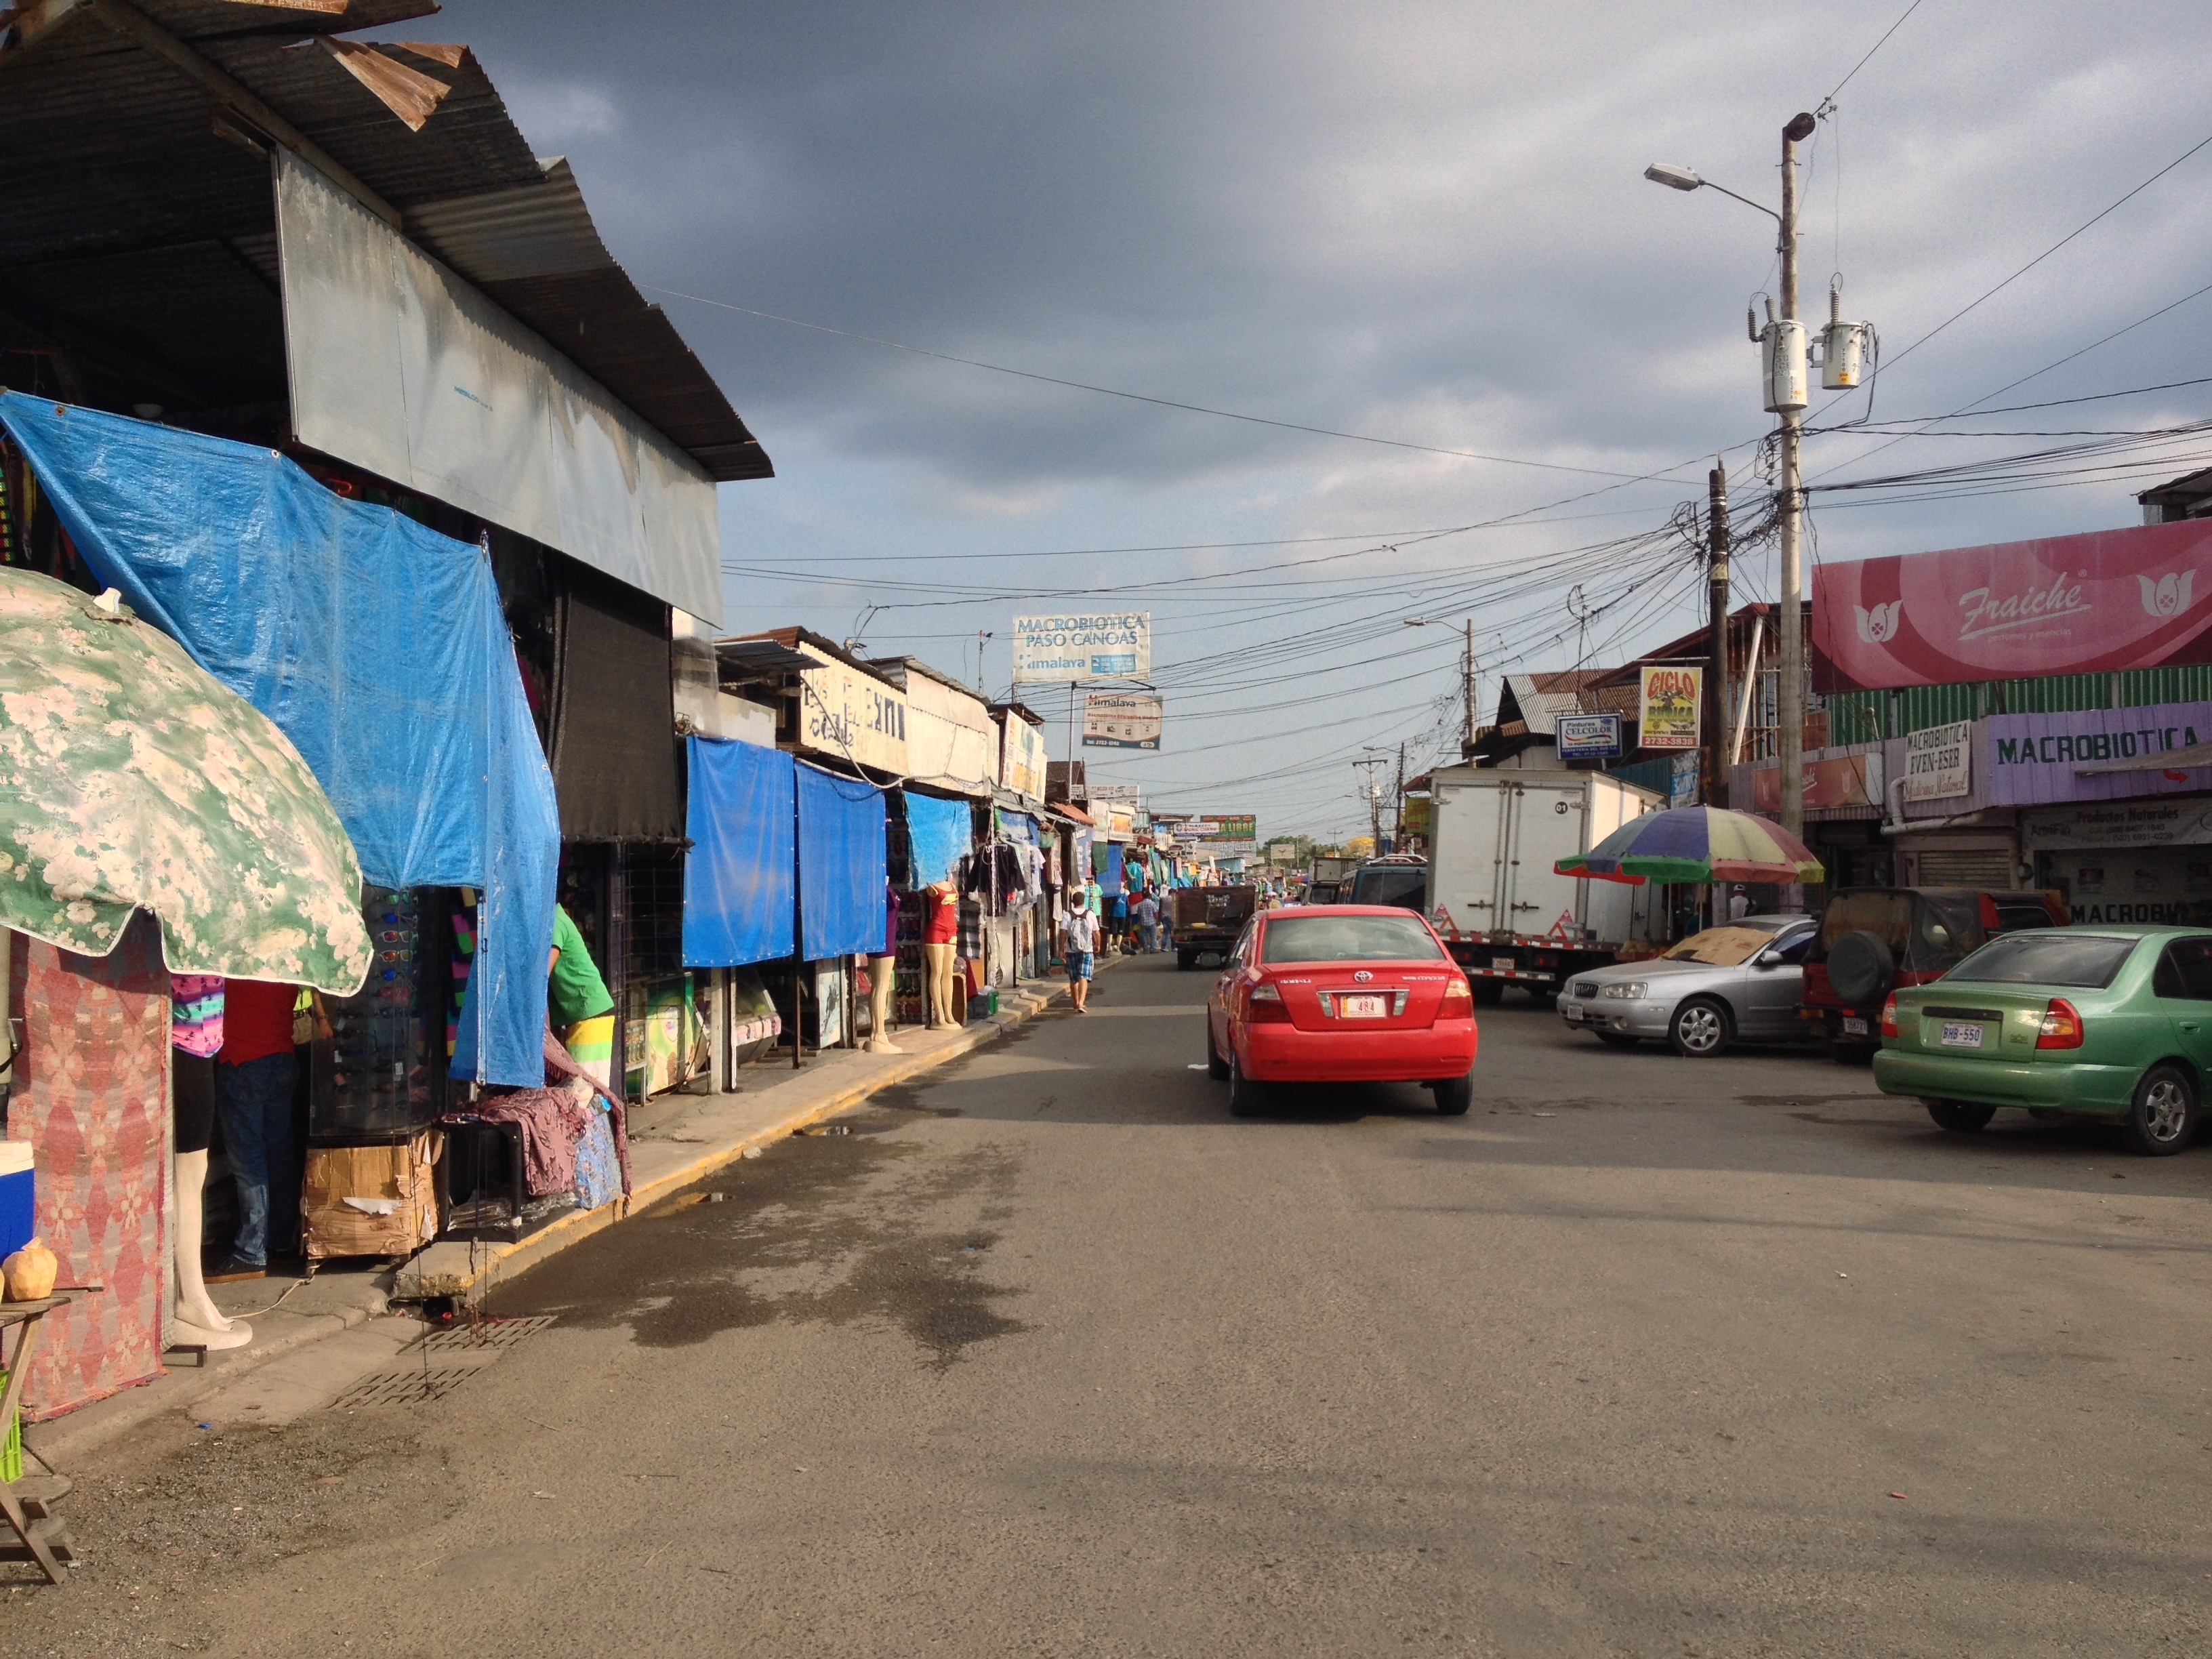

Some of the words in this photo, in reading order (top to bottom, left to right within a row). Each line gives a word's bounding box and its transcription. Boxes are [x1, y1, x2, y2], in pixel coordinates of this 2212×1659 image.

[1958, 571, 2082, 633] Fraiche
[1018, 615, 1145, 634] MACROBIOTICA
[1026, 633, 1067, 648] PASO
[1071, 630, 1138, 647] CANOAS
[1988, 631, 2027, 642] perfumes
[2028, 632, 2033, 640] y
[2036, 628, 2072, 638] esencias
[1647, 671, 1696, 700] CICLO
[1088, 694, 1136, 708] Himalaya
[1565, 726, 1612, 735] CELCOLOR
[1906, 722, 1968, 753] MACROBIOTICA
[1645, 737, 1694, 745] 2732-3838
[1996, 726, 2198, 765] MACROBIOTICA
[1910, 747, 1959, 775] EVEN-ESER
[2077, 809, 2125, 825] Productos
[2129, 806, 2179, 821] Naturales
[1228, 823, 1254, 832] LIBRE
[1357, 998, 1374, 1011] 484
[1942, 1027, 1980, 1041] BHB-550
